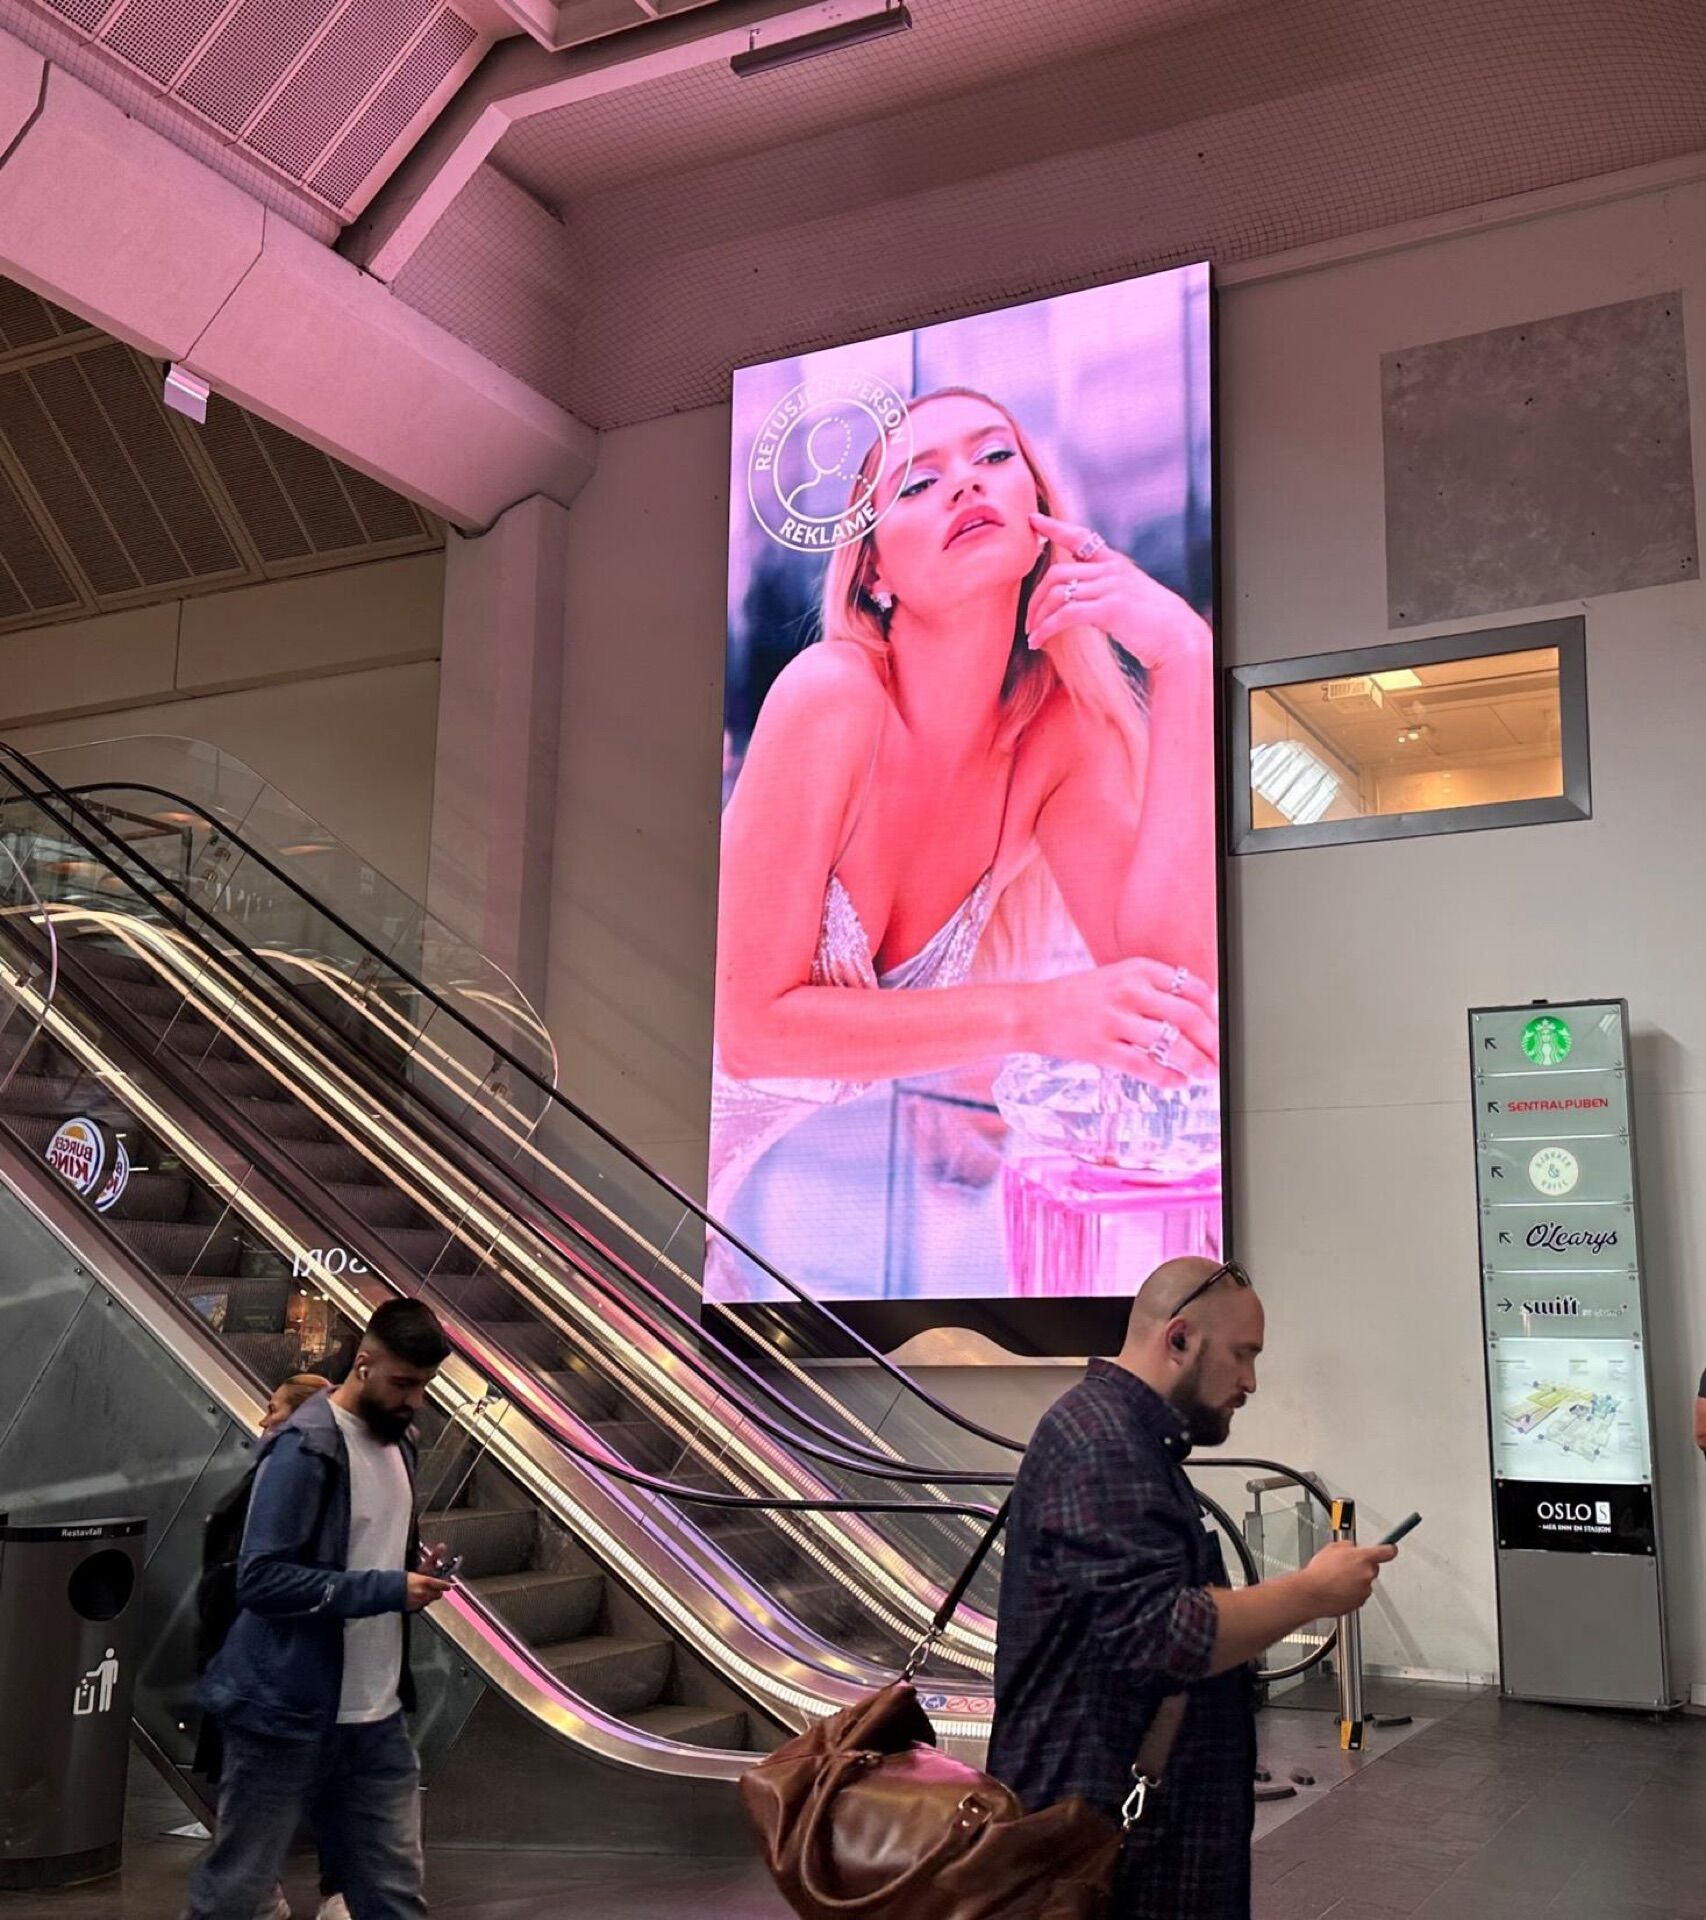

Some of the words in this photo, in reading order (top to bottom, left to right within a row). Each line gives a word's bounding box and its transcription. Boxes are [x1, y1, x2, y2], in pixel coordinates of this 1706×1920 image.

[851, 376, 907, 446] PERSON
[779, 501, 878, 545] REKLAME
[1506, 1098, 1609, 1113] SENTRALPUBEN
[1526, 1222, 1618, 1254] O'Learys
[1537, 1501, 1592, 1521] OSLO
[1597, 1503, 1609, 1522] S
[61, 1527, 103, 1537] Restavfall
